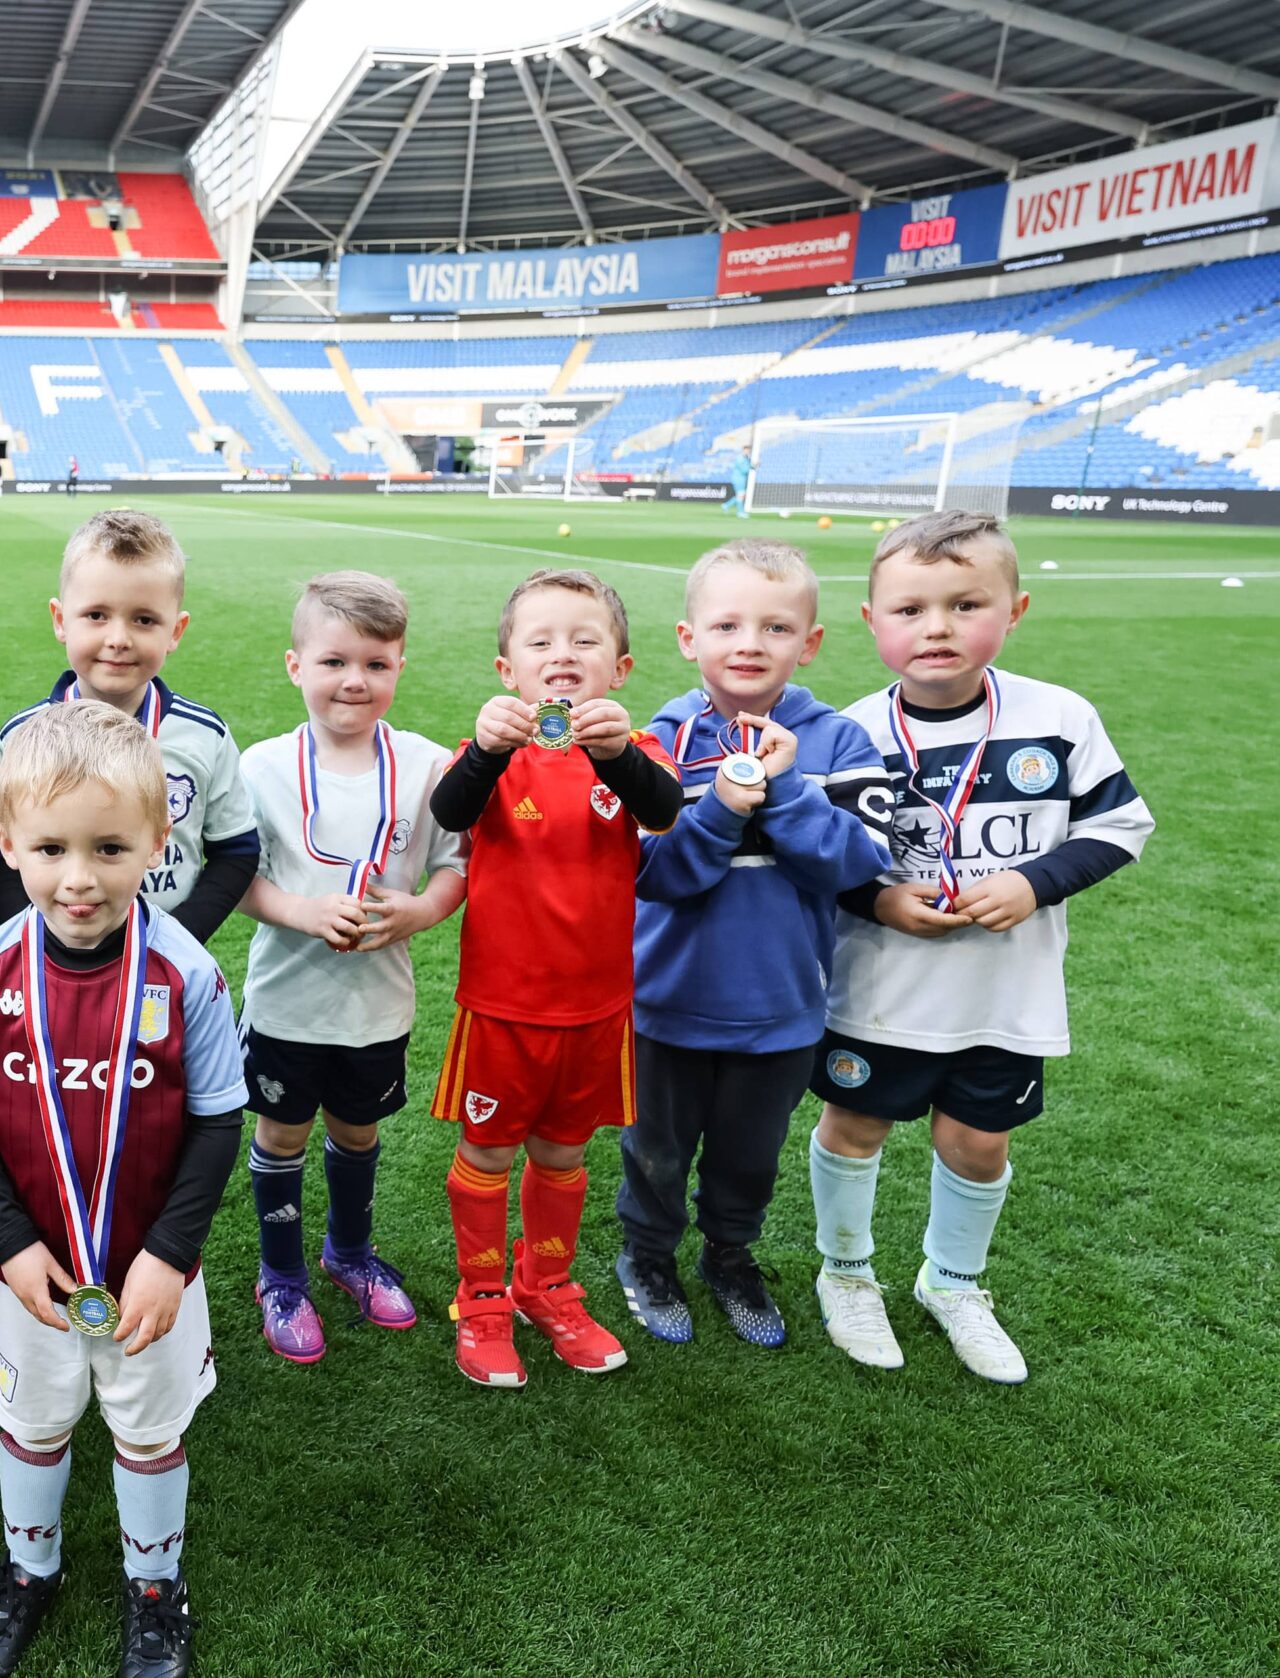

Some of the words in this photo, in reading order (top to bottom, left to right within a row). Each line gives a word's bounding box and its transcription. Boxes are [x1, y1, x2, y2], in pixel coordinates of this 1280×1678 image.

[1016, 182, 1090, 238] VISIT
[1098, 143, 1257, 221] VIETNAM
[910, 194, 953, 223] VISIT
[727, 231, 851, 265] morgansconsult
[885, 243, 962, 276] MALAYSIA
[407, 263, 482, 303] VISIT
[487, 252, 639, 300] MALAYSIA
[1051, 494, 1111, 511] SONY
[1138, 499, 1191, 514] Technology
[1193, 499, 1229, 514] Centre
[922, 773, 992, 788] INFAY
[942, 765, 961, 777] TH
[513, 811, 543, 820] adidas
[142, 988, 168, 1001] VFC
